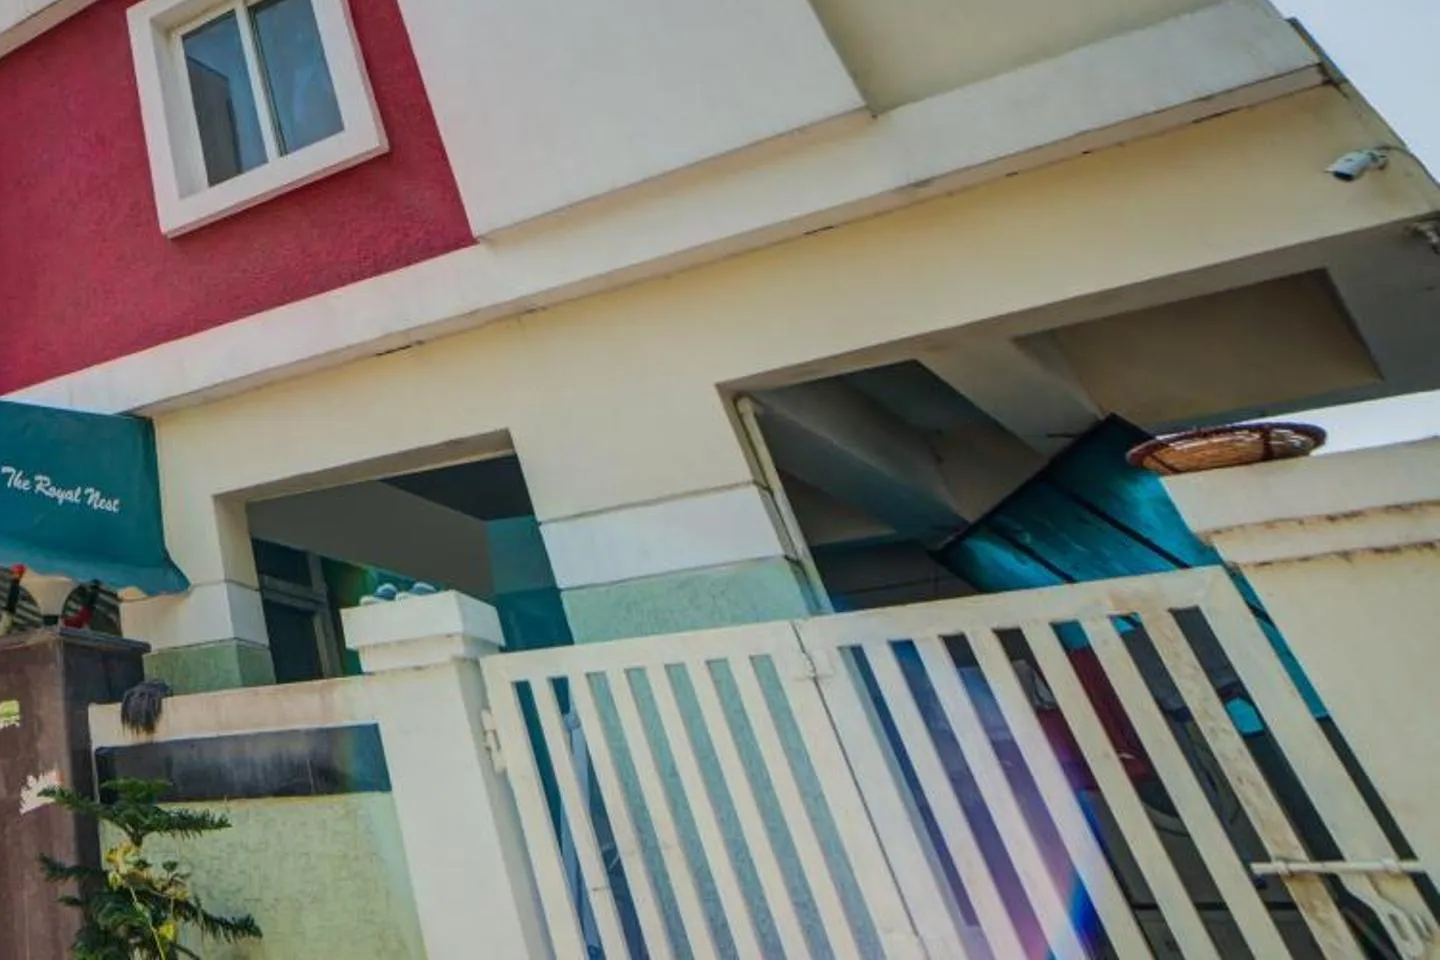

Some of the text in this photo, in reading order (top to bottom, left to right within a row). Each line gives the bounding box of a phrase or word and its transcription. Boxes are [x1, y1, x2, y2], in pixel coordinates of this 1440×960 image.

[1, 466, 31, 490] The
[34, 474, 81, 505] Royal
[84, 487, 120, 513] Nest
